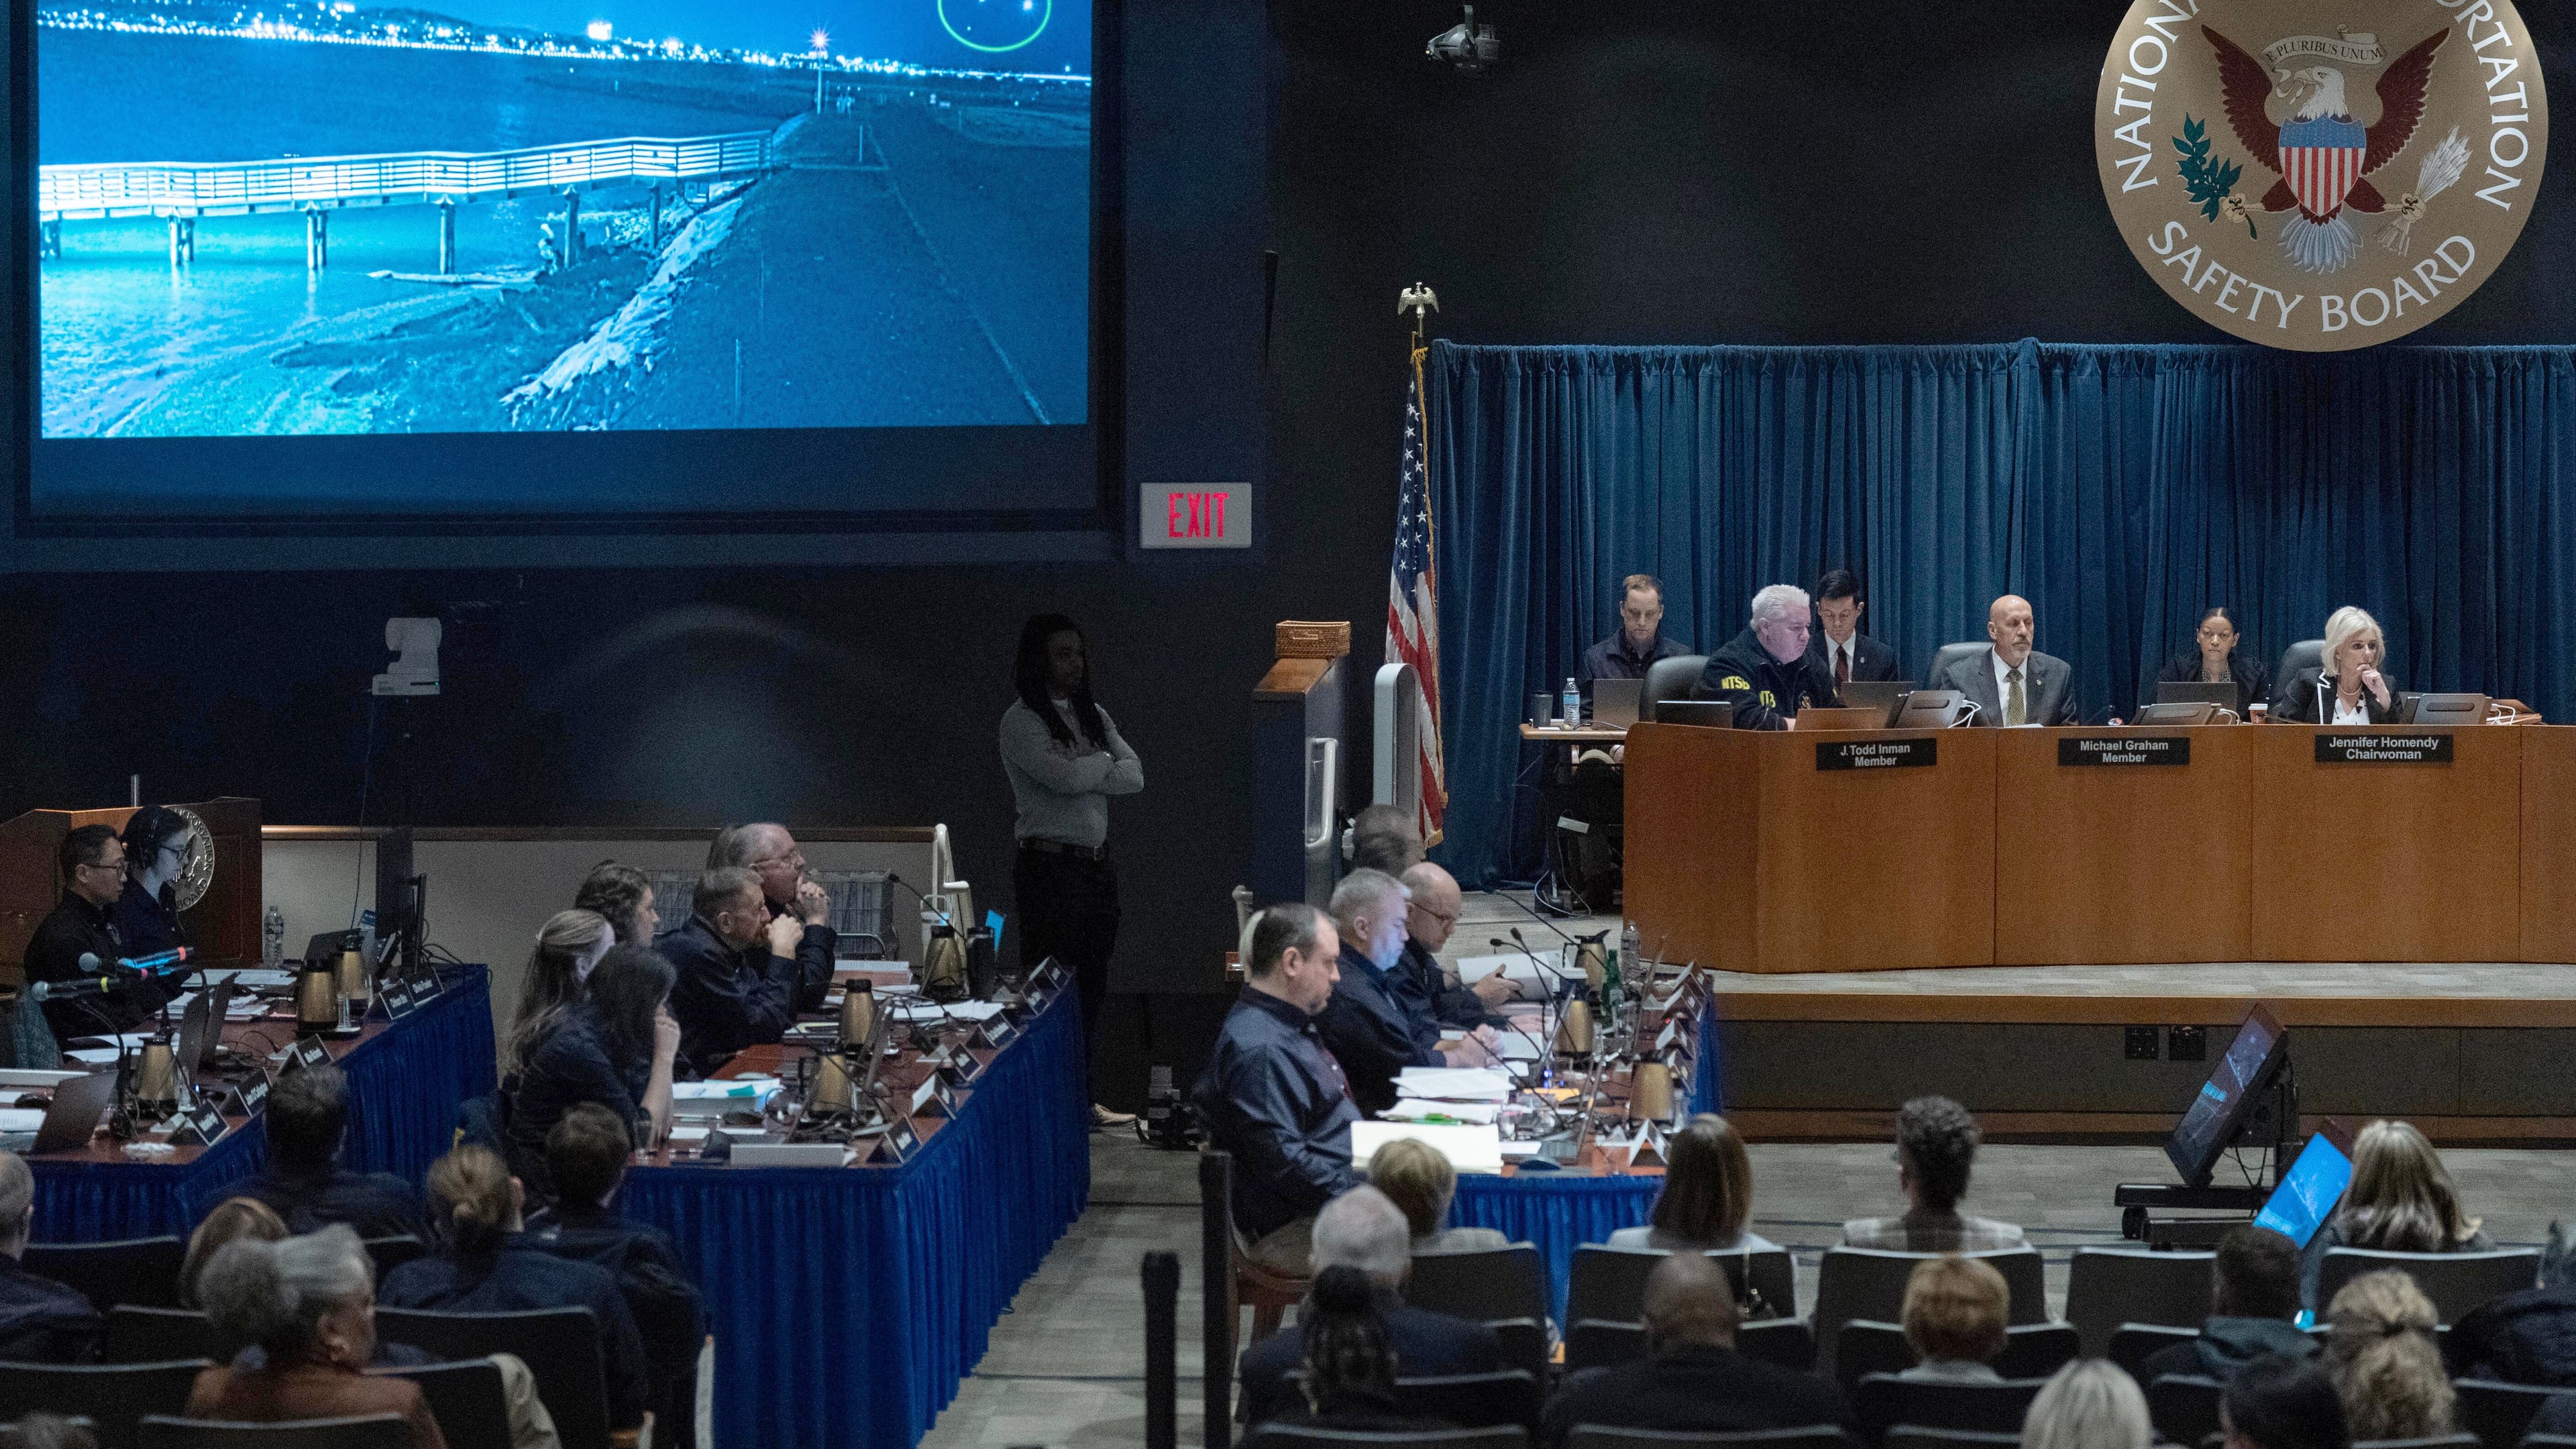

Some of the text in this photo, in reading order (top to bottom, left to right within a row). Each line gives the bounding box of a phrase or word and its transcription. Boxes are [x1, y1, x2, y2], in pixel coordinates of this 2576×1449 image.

[2275, 40, 2337, 56] PLURIBUS
[2340, 46, 2383, 60] UNUM
[2436, 0, 2529, 211] RTATION
[2148, 221, 2476, 332] SAFETY BOARD
[1169, 492, 1229, 538] EXIT
[2080, 740, 2169, 751] Michael Graham
[2329, 737, 2439, 750] Jennifer Homendy
[1840, 744, 1911, 756] J. Todd Inman
[2346, 749, 2422, 760] Chairwoman
[1855, 755, 1897, 767] Member
[2102, 753, 2147, 763] Member
